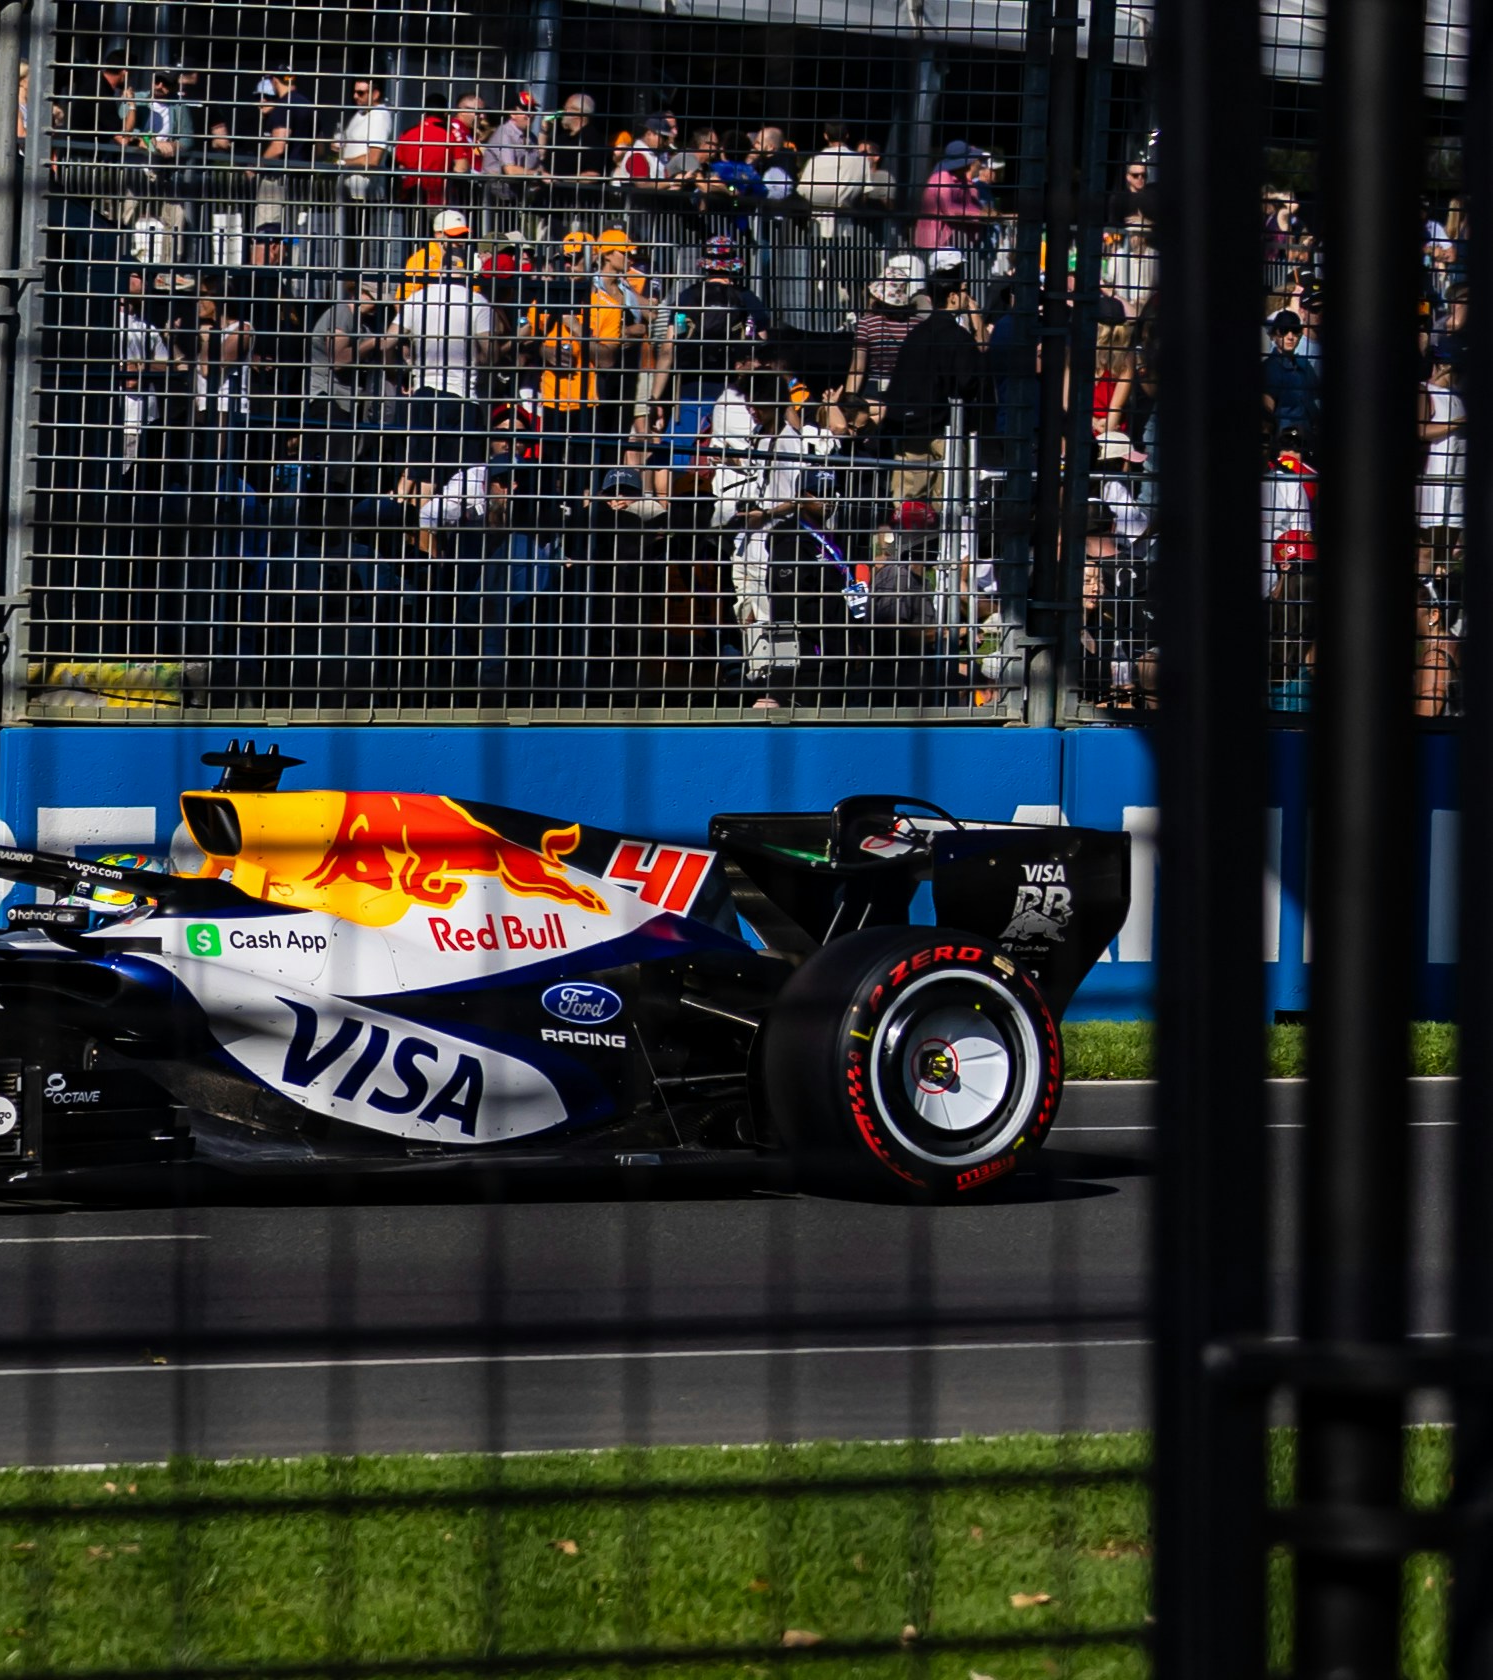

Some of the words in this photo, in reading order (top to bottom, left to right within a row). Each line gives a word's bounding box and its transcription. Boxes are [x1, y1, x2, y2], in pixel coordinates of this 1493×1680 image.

[607, 841, 711, 914] 41
[1020, 864, 1066, 882] VISA
[17, 909, 57, 921] hahnair
[229, 930, 282, 950] Cash
[286, 931, 327, 954] App
[428, 915, 498, 952] Red
[502, 915, 568, 950] Bull
[887, 944, 985, 988] ZERO
[558, 988, 606, 1019] Ford
[541, 1028, 627, 1049] RACING
[275, 995, 486, 1137] VISA
[52, 1090, 102, 1104] OCTAVE
